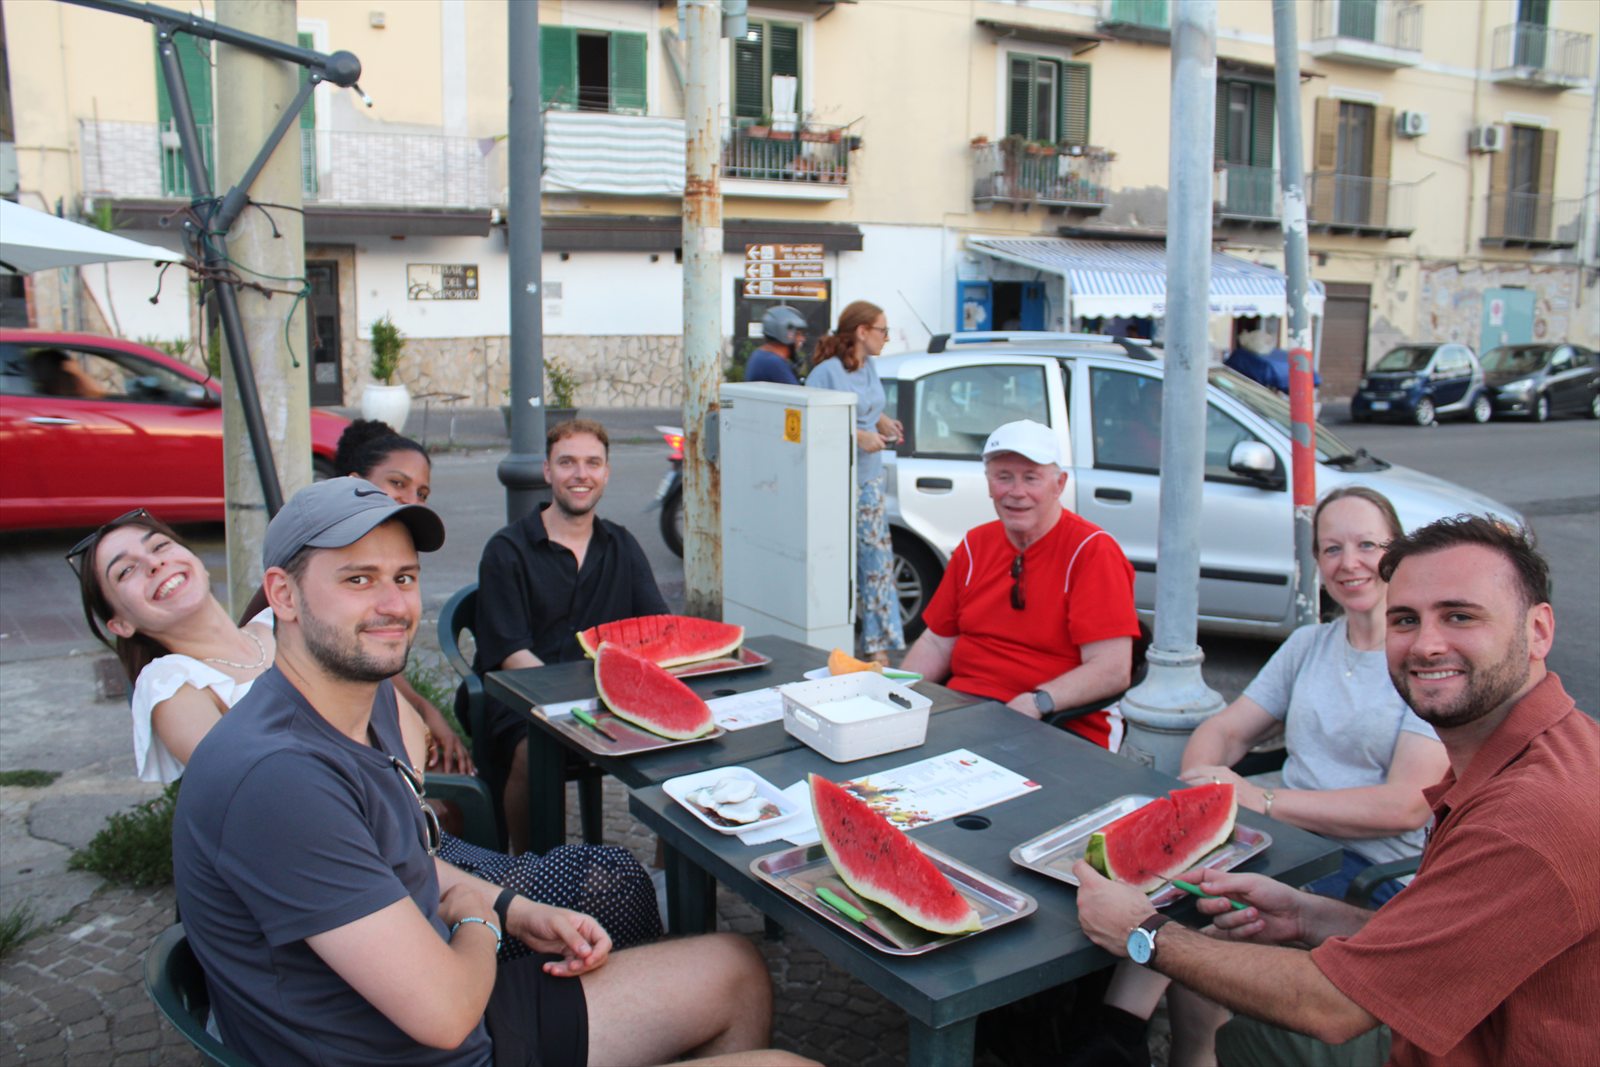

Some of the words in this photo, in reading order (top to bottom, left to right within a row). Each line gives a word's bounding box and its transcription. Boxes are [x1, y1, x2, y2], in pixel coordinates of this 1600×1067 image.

[443, 265, 464, 275] BAR
[443, 277, 462, 287] DEL
[443, 289, 478, 299] PORTO
